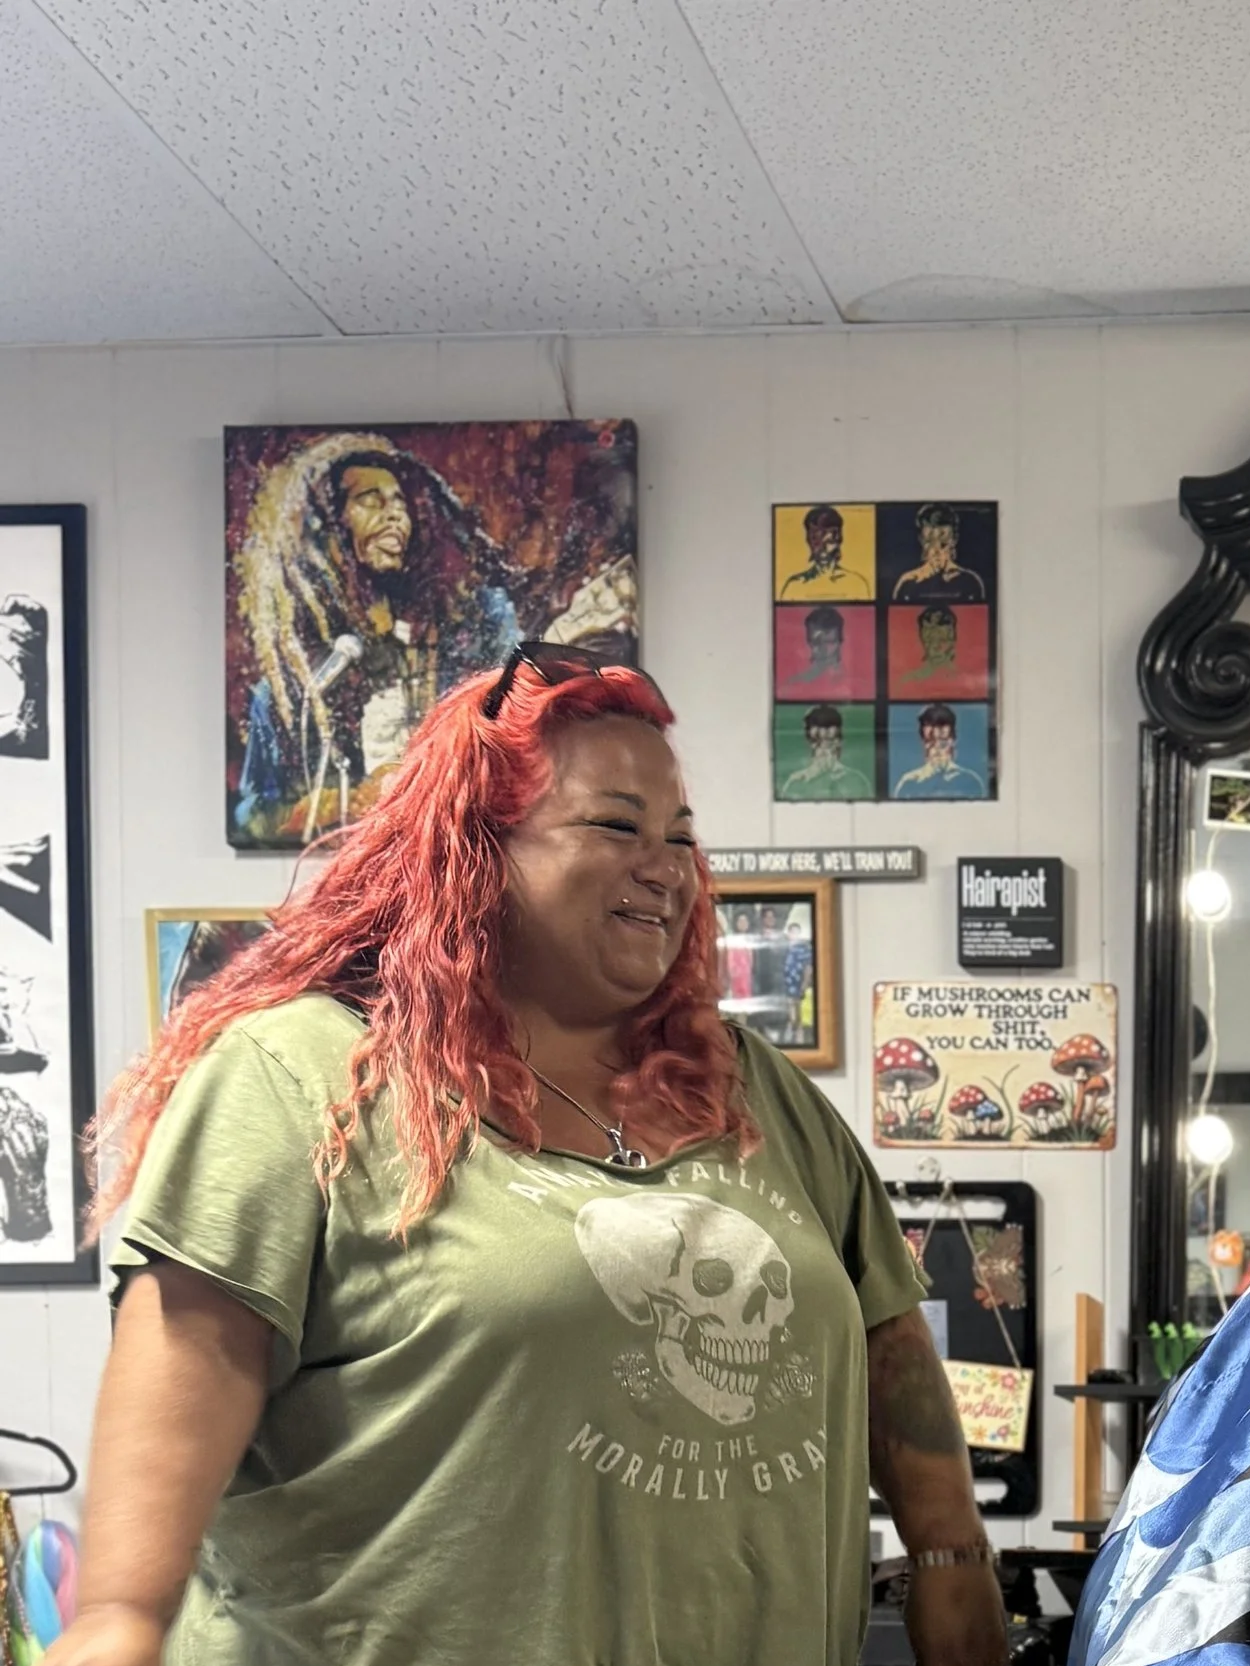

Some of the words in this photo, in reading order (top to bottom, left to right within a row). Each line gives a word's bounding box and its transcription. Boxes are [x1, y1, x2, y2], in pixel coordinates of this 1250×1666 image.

[743, 853, 756, 872] TO
[759, 852, 789, 872] WORK
[855, 851, 885, 872] TRAIN
[887, 849, 912, 871] YOU!
[962, 864, 1047, 917] Hairapist
[893, 986, 914, 1002] IF
[917, 986, 1043, 1002] MUSHROOMS
[1048, 987, 1091, 1003] CAN
[905, 1003, 968, 1018] GROW
[973, 1004, 1068, 1019] THROUGH
[992, 1020, 1046, 1037] SHIT,
[926, 1036, 965, 1050] YOU
[970, 1036, 1009, 1050] CAN
[664, 1159, 803, 1226] FALLING
[658, 1434, 700, 1462] FOR
[714, 1434, 758, 1463] THE
[567, 1422, 728, 1500] MORALLY
